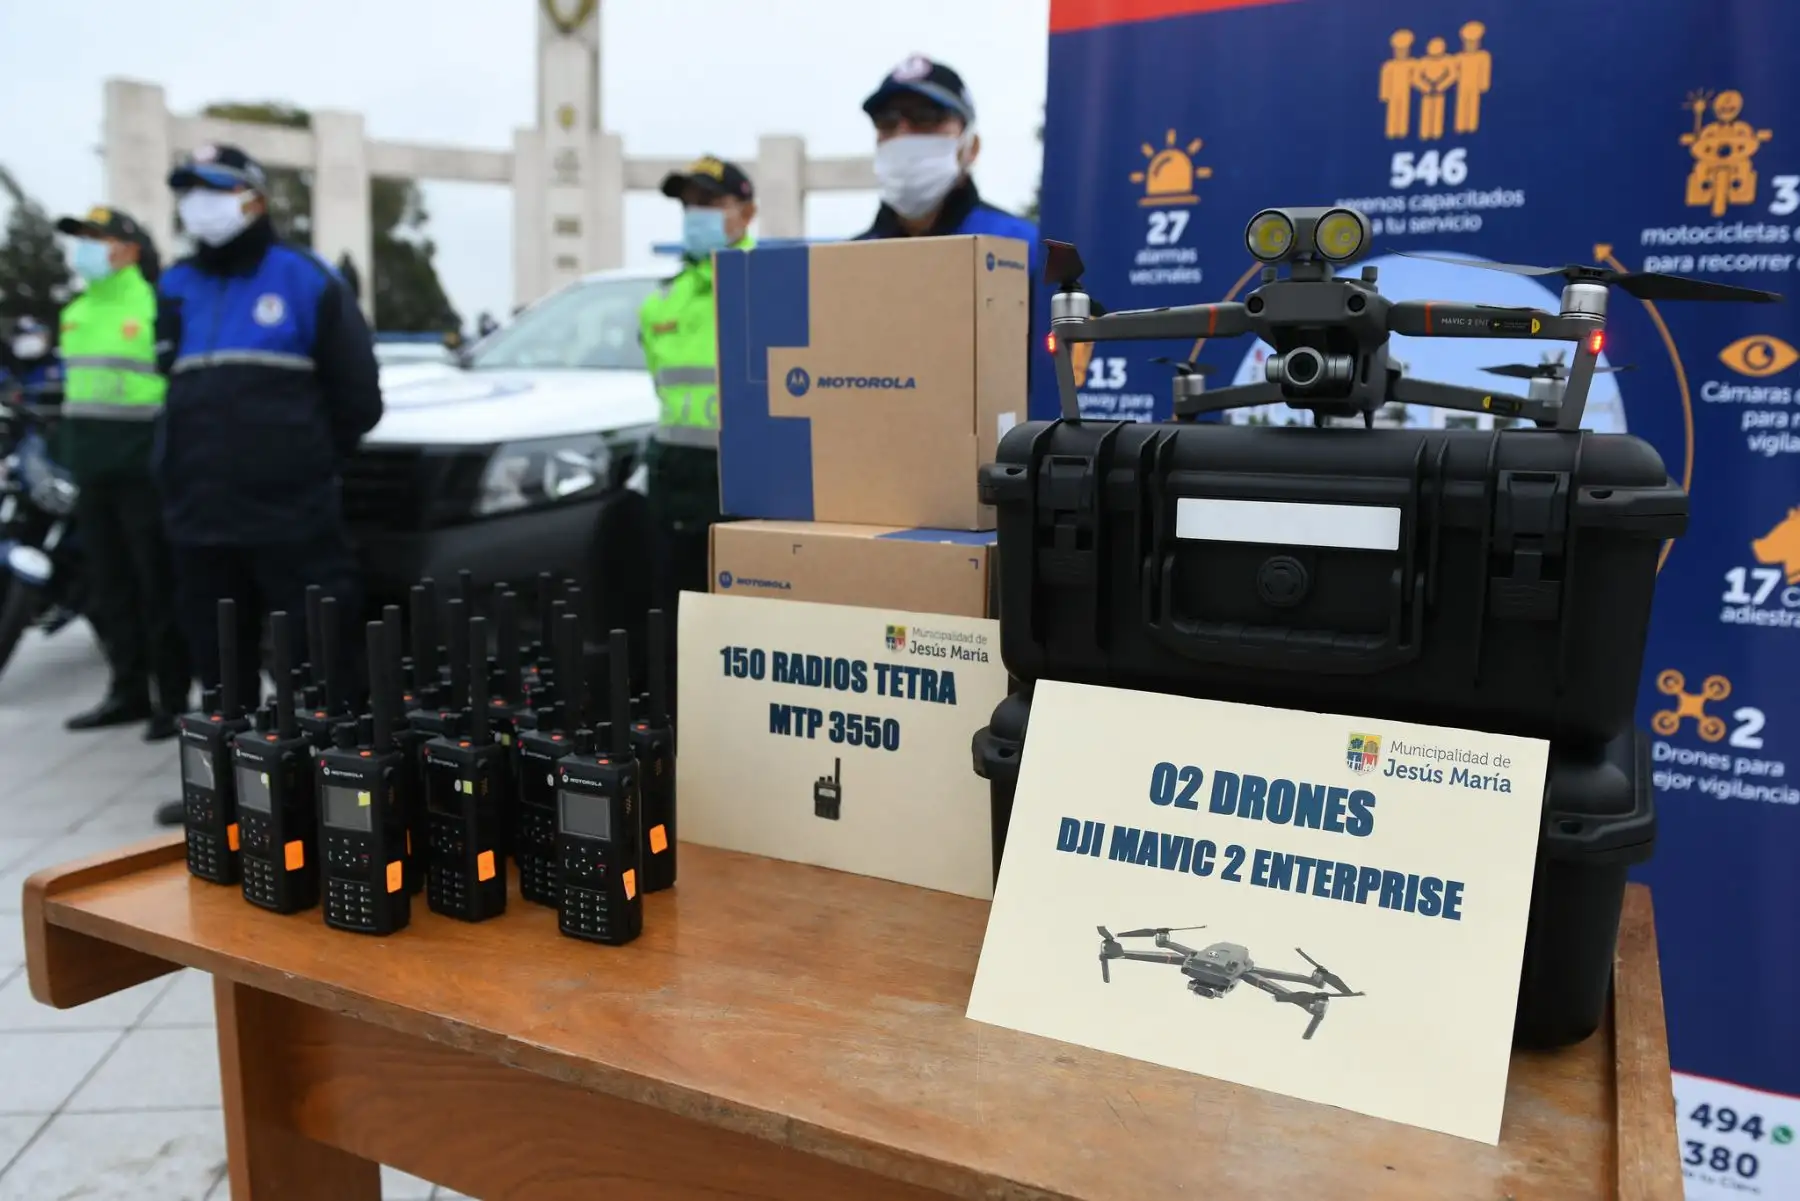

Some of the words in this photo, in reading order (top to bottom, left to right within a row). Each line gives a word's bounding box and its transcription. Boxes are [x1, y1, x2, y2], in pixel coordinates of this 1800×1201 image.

[1390, 147, 1468, 189] 546
[1408, 187, 1525, 213] capacitados
[1146, 209, 1190, 245] 27
[1385, 216, 1406, 235] tu
[1408, 212, 1482, 235] servicio
[1641, 221, 1790, 246] motocicletas
[1643, 254, 1694, 273] para
[1697, 253, 1795, 272] recorrer
[1441, 317, 1465, 326] MAVIC
[817, 376, 916, 389] MOTOROLA
[1087, 357, 1127, 390] 13
[1701, 380, 1791, 404] Cámaras
[1741, 410, 1789, 431] para
[737, 577, 791, 590] MOTOROLA
[1722, 566, 1781, 605] 17
[910, 641, 946, 658] Jesús
[951, 644, 989, 663] María
[913, 627, 973, 644] Municipalidad
[975, 634, 988, 645] de
[720, 647, 765, 680] 150
[772, 651, 867, 693] RADIOS
[874, 662, 957, 705] TETRA
[769, 703, 823, 739] MTP
[829, 711, 900, 752] 3550
[1729, 706, 1766, 749] 2
[1390, 740, 1488, 766] Municipalidad
[1493, 753, 1511, 769] de
[1652, 741, 1730, 771] Drones
[1733, 757, 1785, 778] para
[570, 778, 602, 787] MOTOROLA
[1383, 758, 1443, 784] Jesús
[1448, 767, 1512, 793] María
[1653, 769, 1695, 791] ejor
[1698, 775, 1800, 805] vigilancia
[1149, 761, 1203, 810] 02
[1209, 770, 1376, 837] DRONES
[1056, 816, 1104, 857] DJI
[1109, 825, 1216, 877] MAVIC
[1221, 844, 1246, 882] 2
[1250, 848, 1465, 921] ENTERPRISE
[1690, 1103, 1764, 1141] 494
[1684, 1140, 1759, 1180] 380
